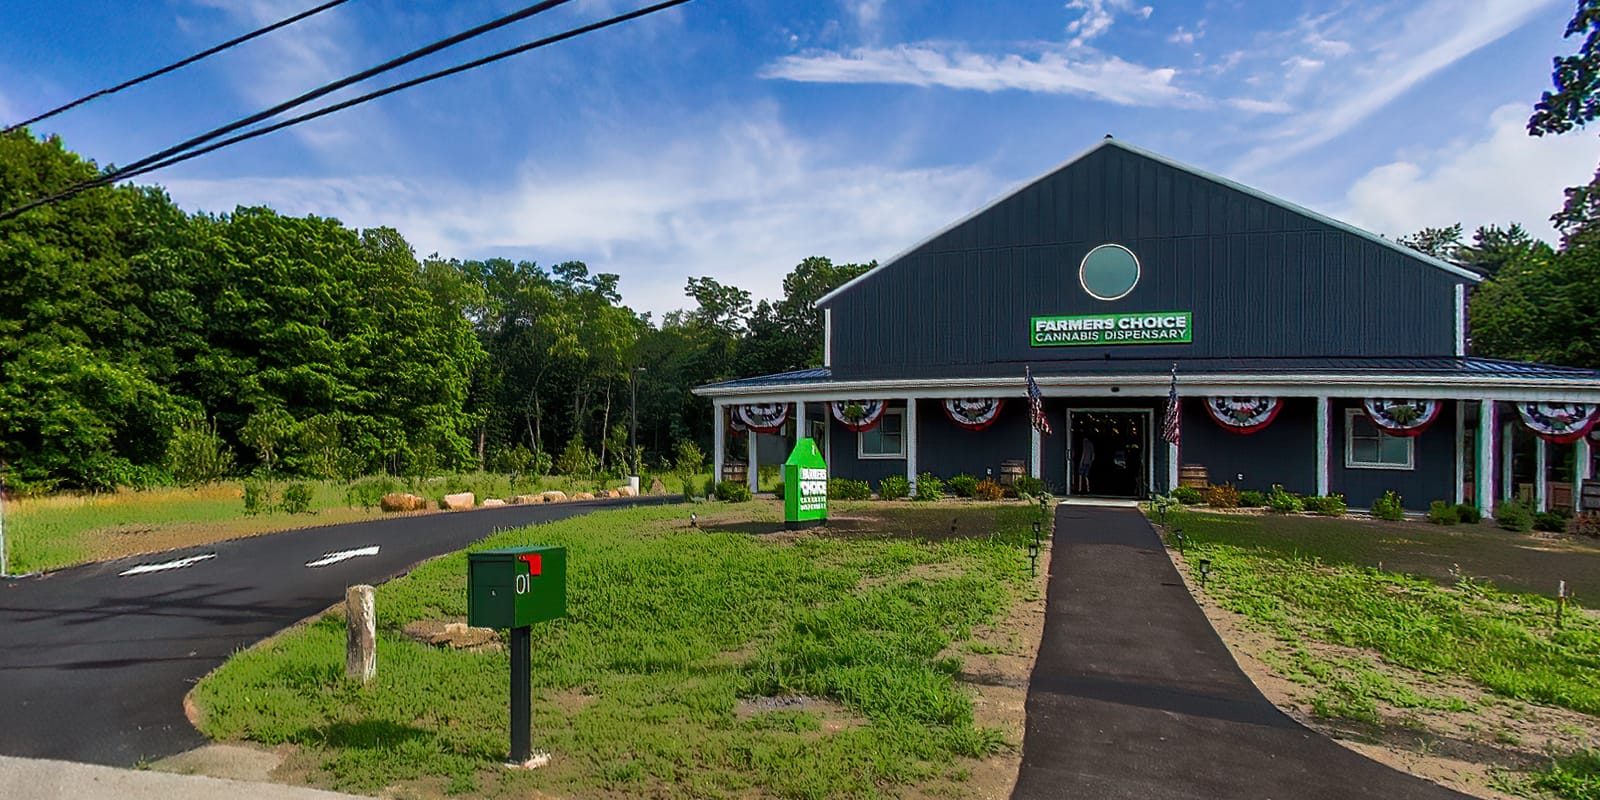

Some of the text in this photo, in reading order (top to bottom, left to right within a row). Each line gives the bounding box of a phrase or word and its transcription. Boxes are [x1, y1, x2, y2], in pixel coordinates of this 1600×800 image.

[1035, 316, 1186, 332] FARMERS CHOICE
[1035, 329, 1187, 342] CANNABIS DISPENSARY
[516, 573, 530, 595] 01
